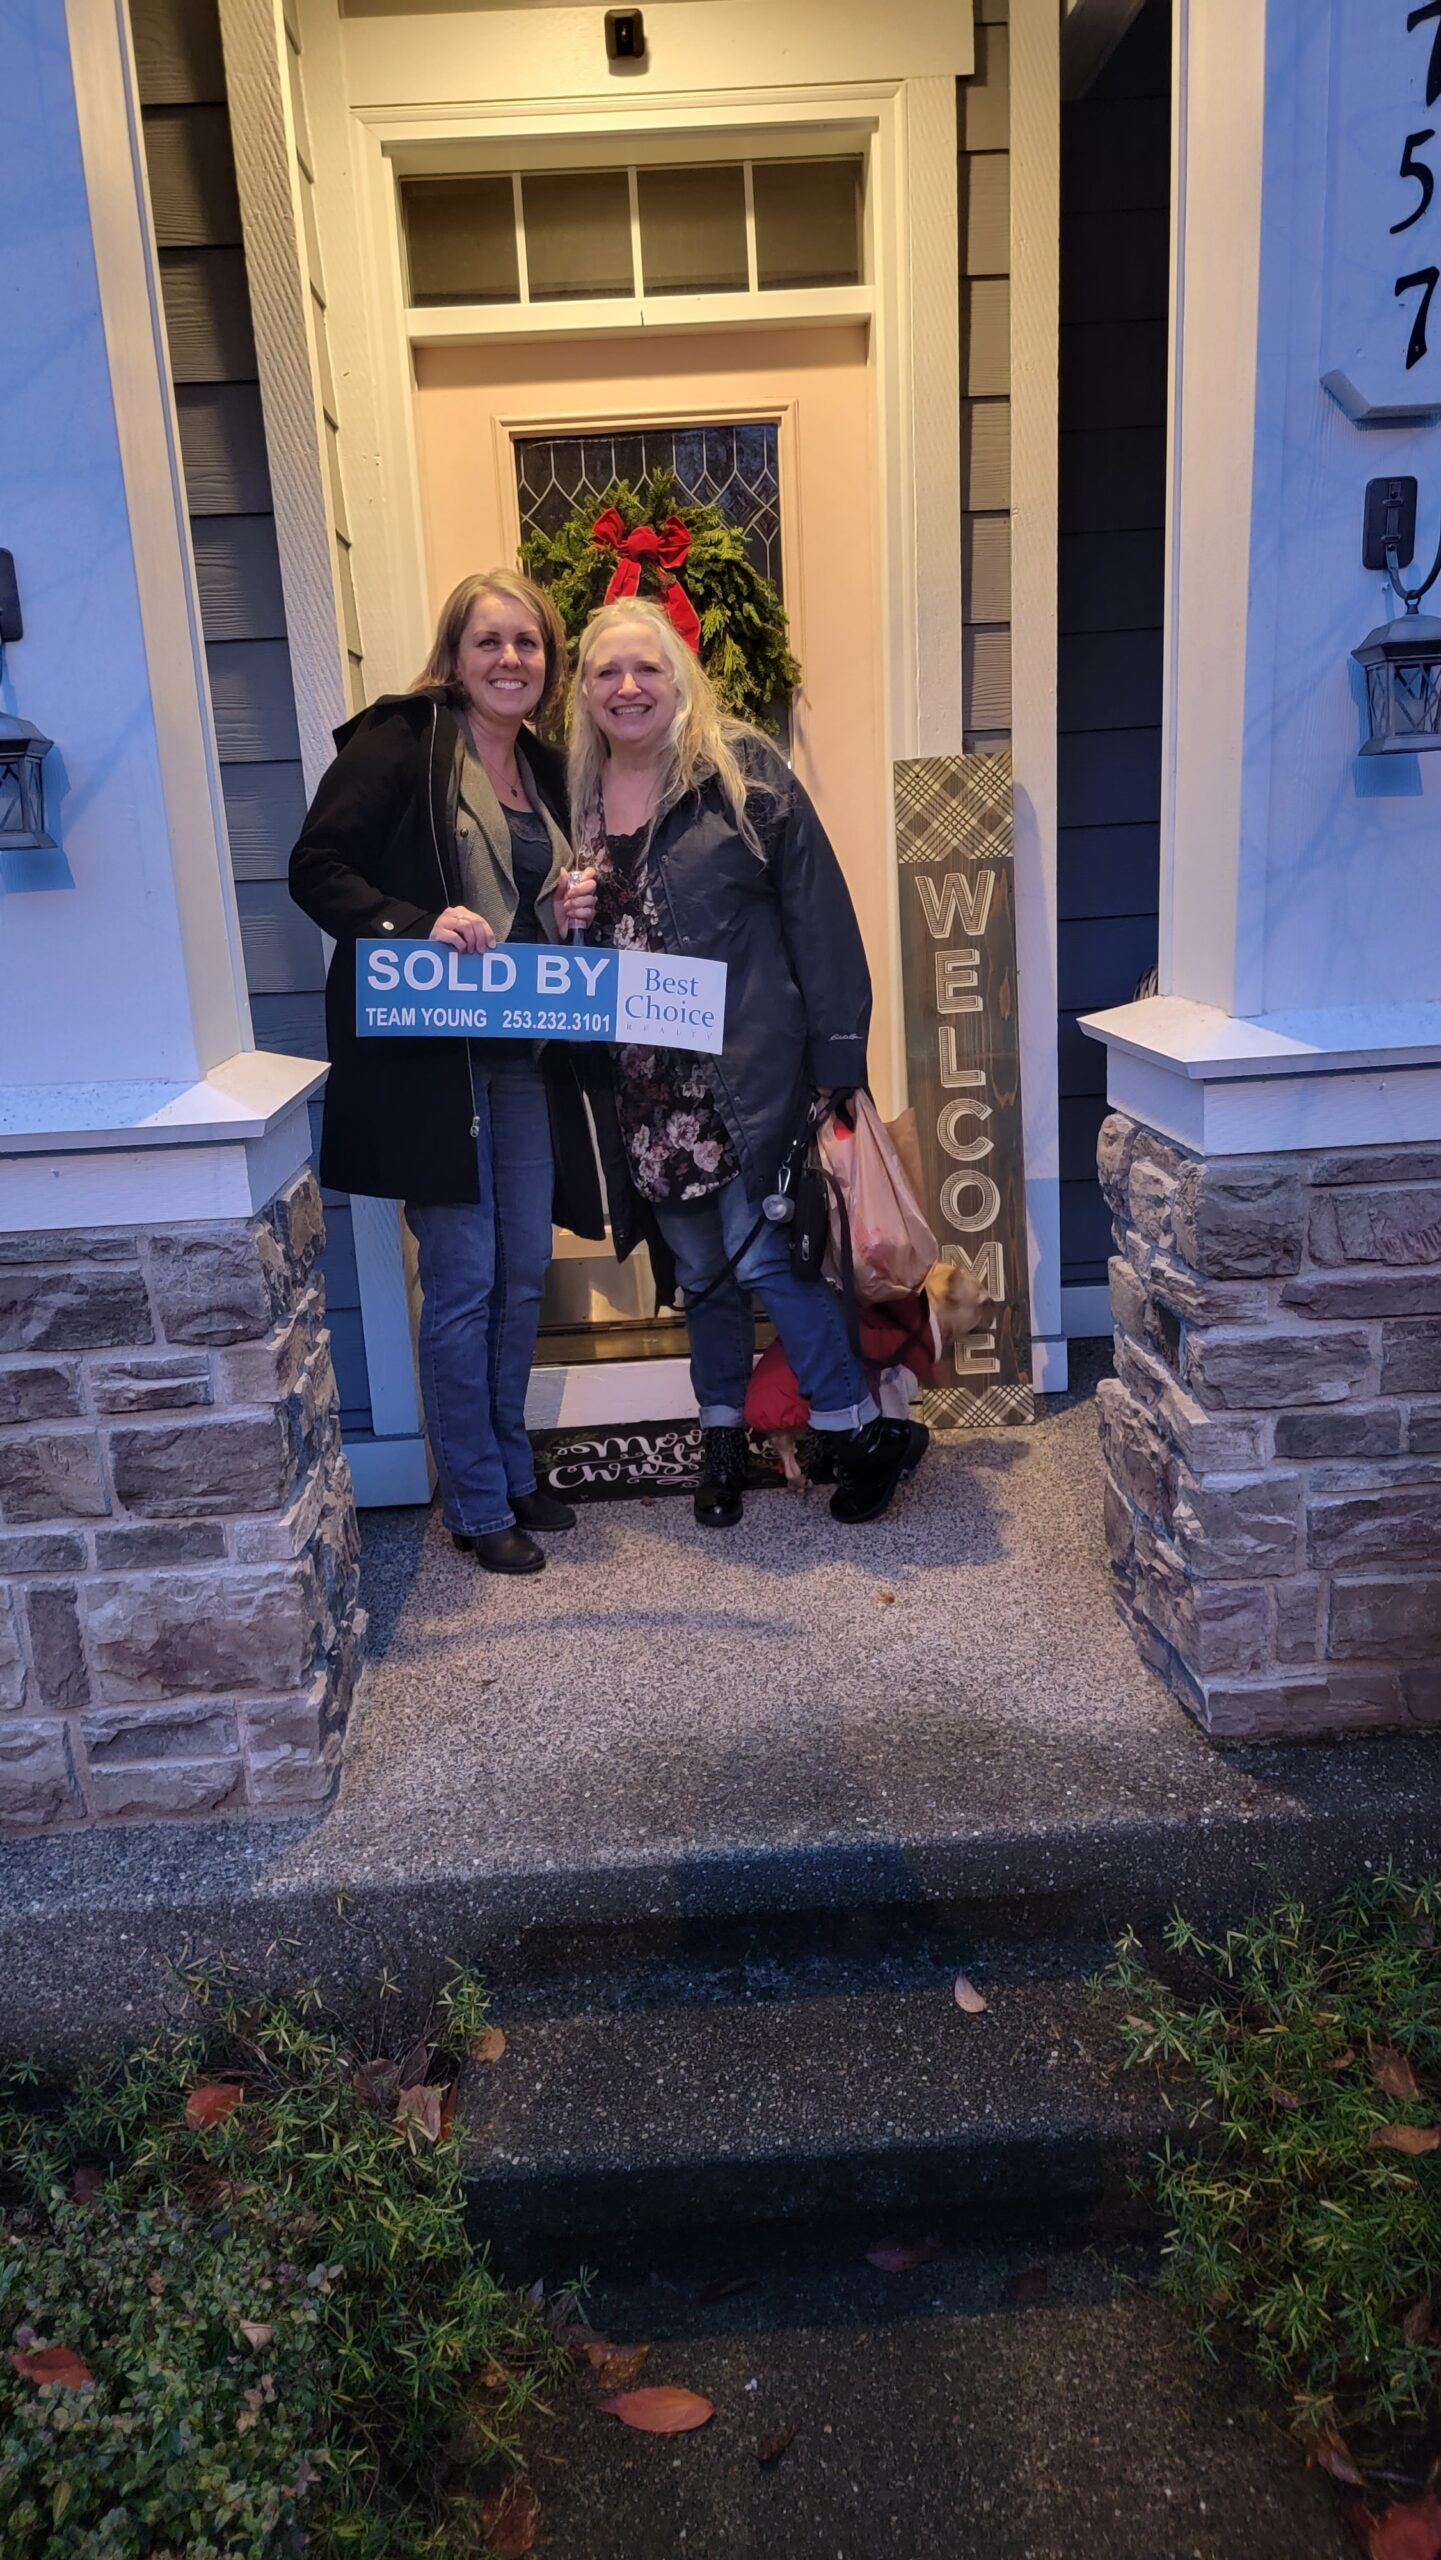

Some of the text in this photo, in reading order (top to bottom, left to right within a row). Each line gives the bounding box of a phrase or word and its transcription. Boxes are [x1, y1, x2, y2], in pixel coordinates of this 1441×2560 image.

[367, 949, 611, 997] SOLD BY
[644, 967, 700, 997] Best
[365, 1007, 611, 1033] TEAM YOUNG 253.232.3101
[624, 994, 715, 1028] Choice
[914, 869, 1006, 1376] WELCOME
